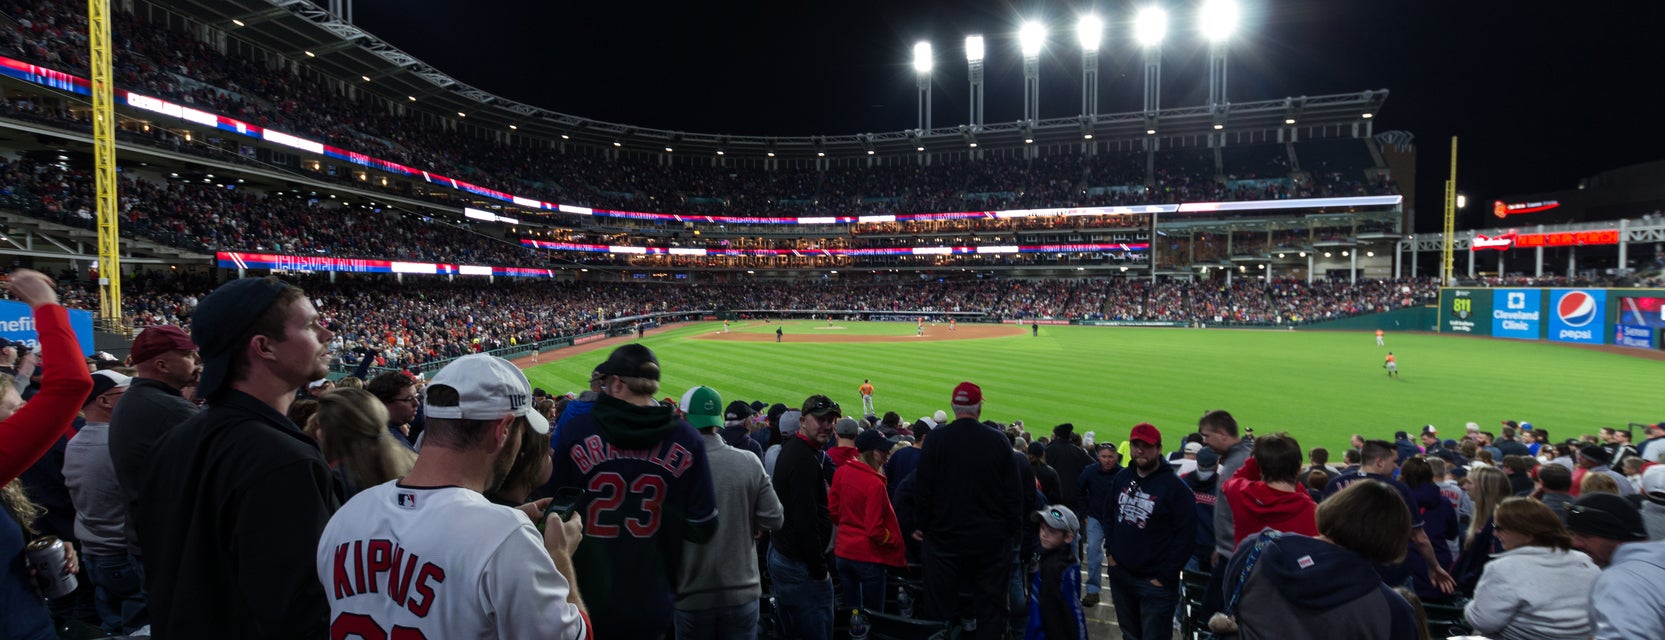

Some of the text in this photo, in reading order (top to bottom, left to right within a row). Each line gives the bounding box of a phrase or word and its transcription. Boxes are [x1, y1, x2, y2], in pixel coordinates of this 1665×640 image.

[1453, 298, 1471, 313] 811
[1493, 310, 1540, 321] Cleveland
[1502, 320, 1529, 331] Clinic
[1559, 330, 1592, 340] pepsi
[585, 471, 668, 538] 23
